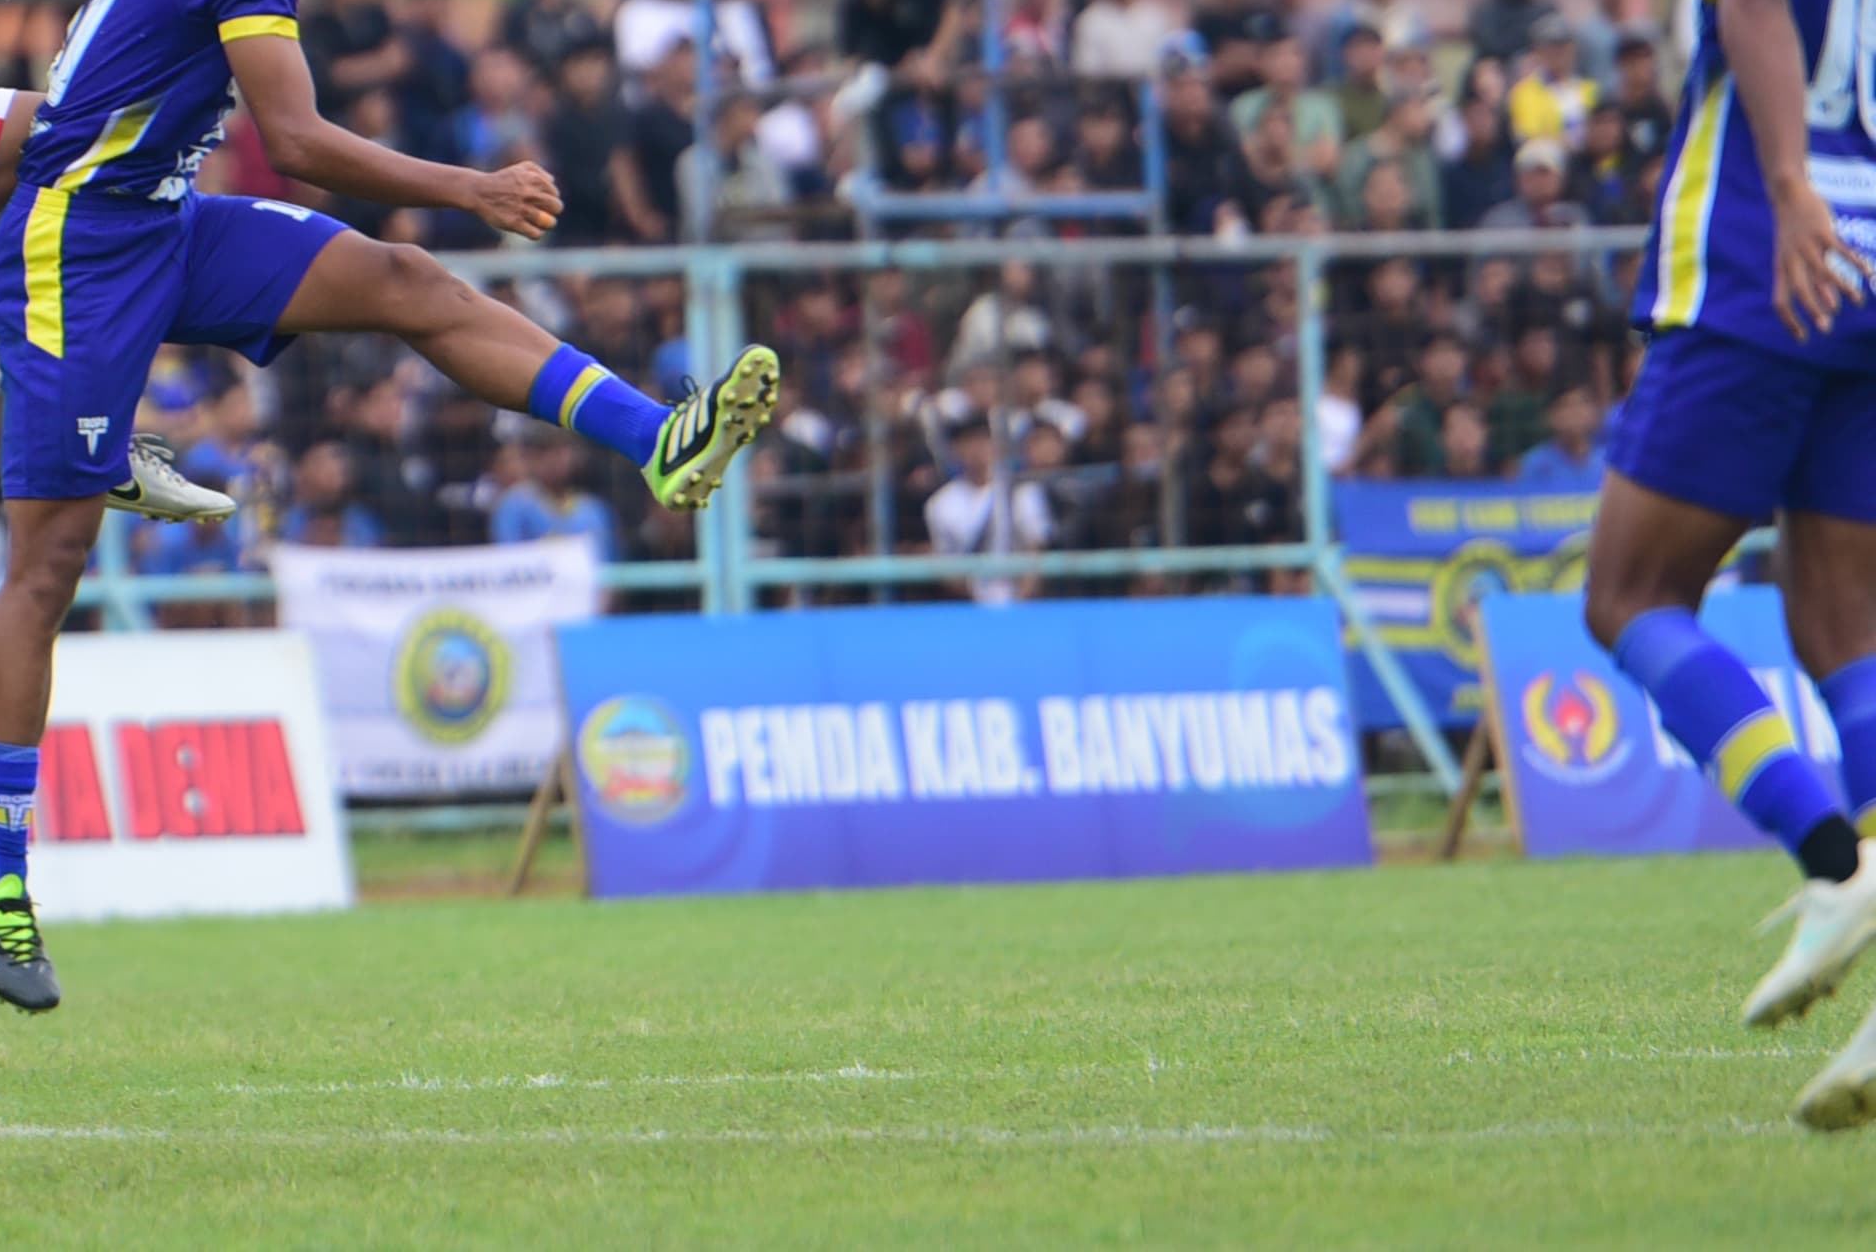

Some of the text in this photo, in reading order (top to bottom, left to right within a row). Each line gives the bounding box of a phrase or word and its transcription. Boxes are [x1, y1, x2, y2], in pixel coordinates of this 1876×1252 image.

[701, 686, 1348, 808] PEMDA KAB. BANYUMAS
